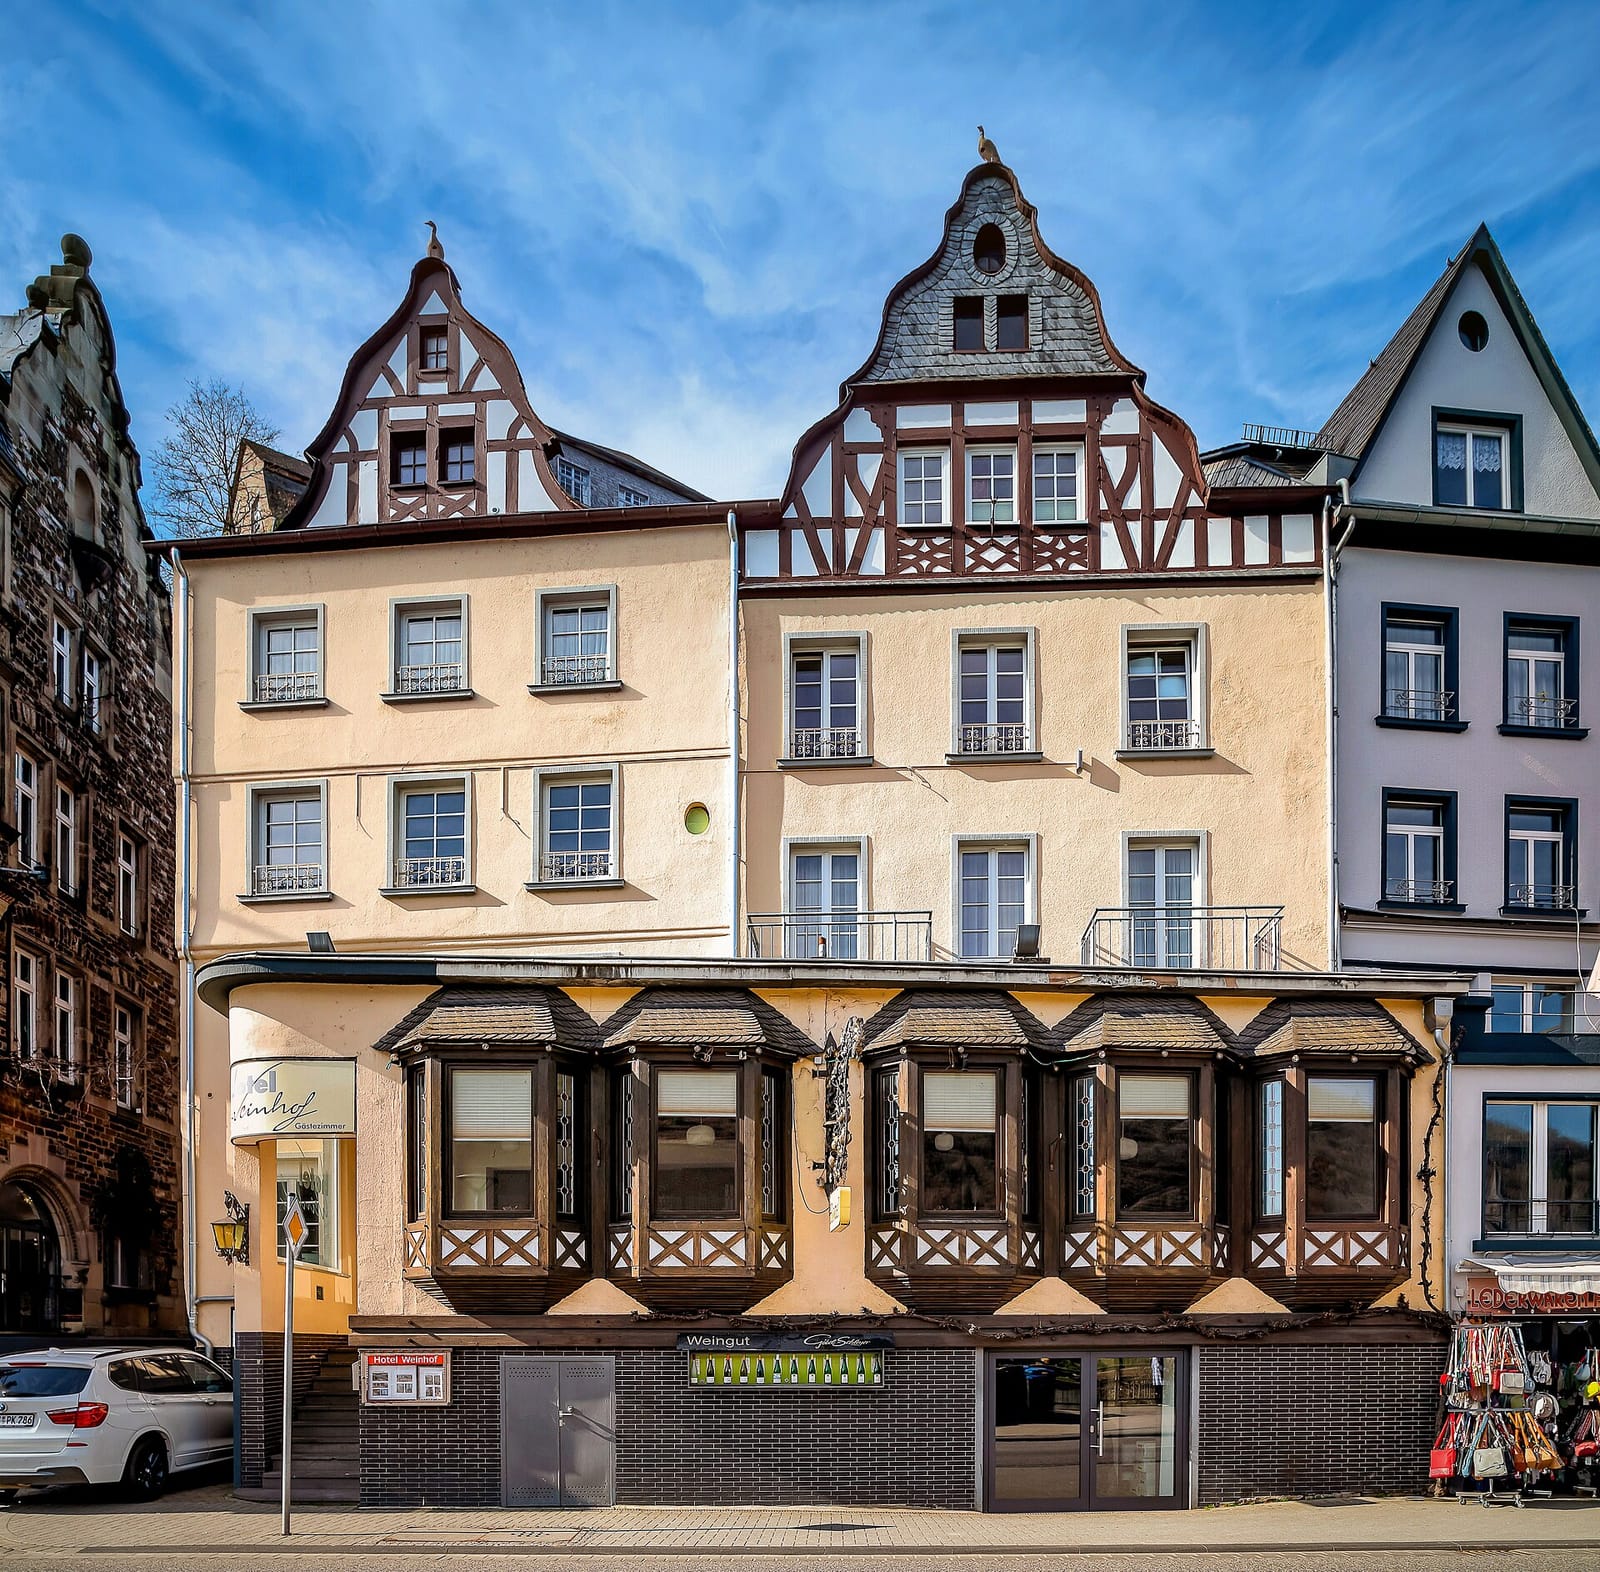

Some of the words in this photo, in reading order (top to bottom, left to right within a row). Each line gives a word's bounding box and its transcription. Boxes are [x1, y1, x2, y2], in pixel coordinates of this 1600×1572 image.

[687, 1335, 750, 1348] Weingut
[373, 1355, 398, 1364] Hotel
[401, 1355, 438, 1364] Weinhof
[6, 1415, 16, 1424] PK
[18, 1415, 32, 1424] 786
